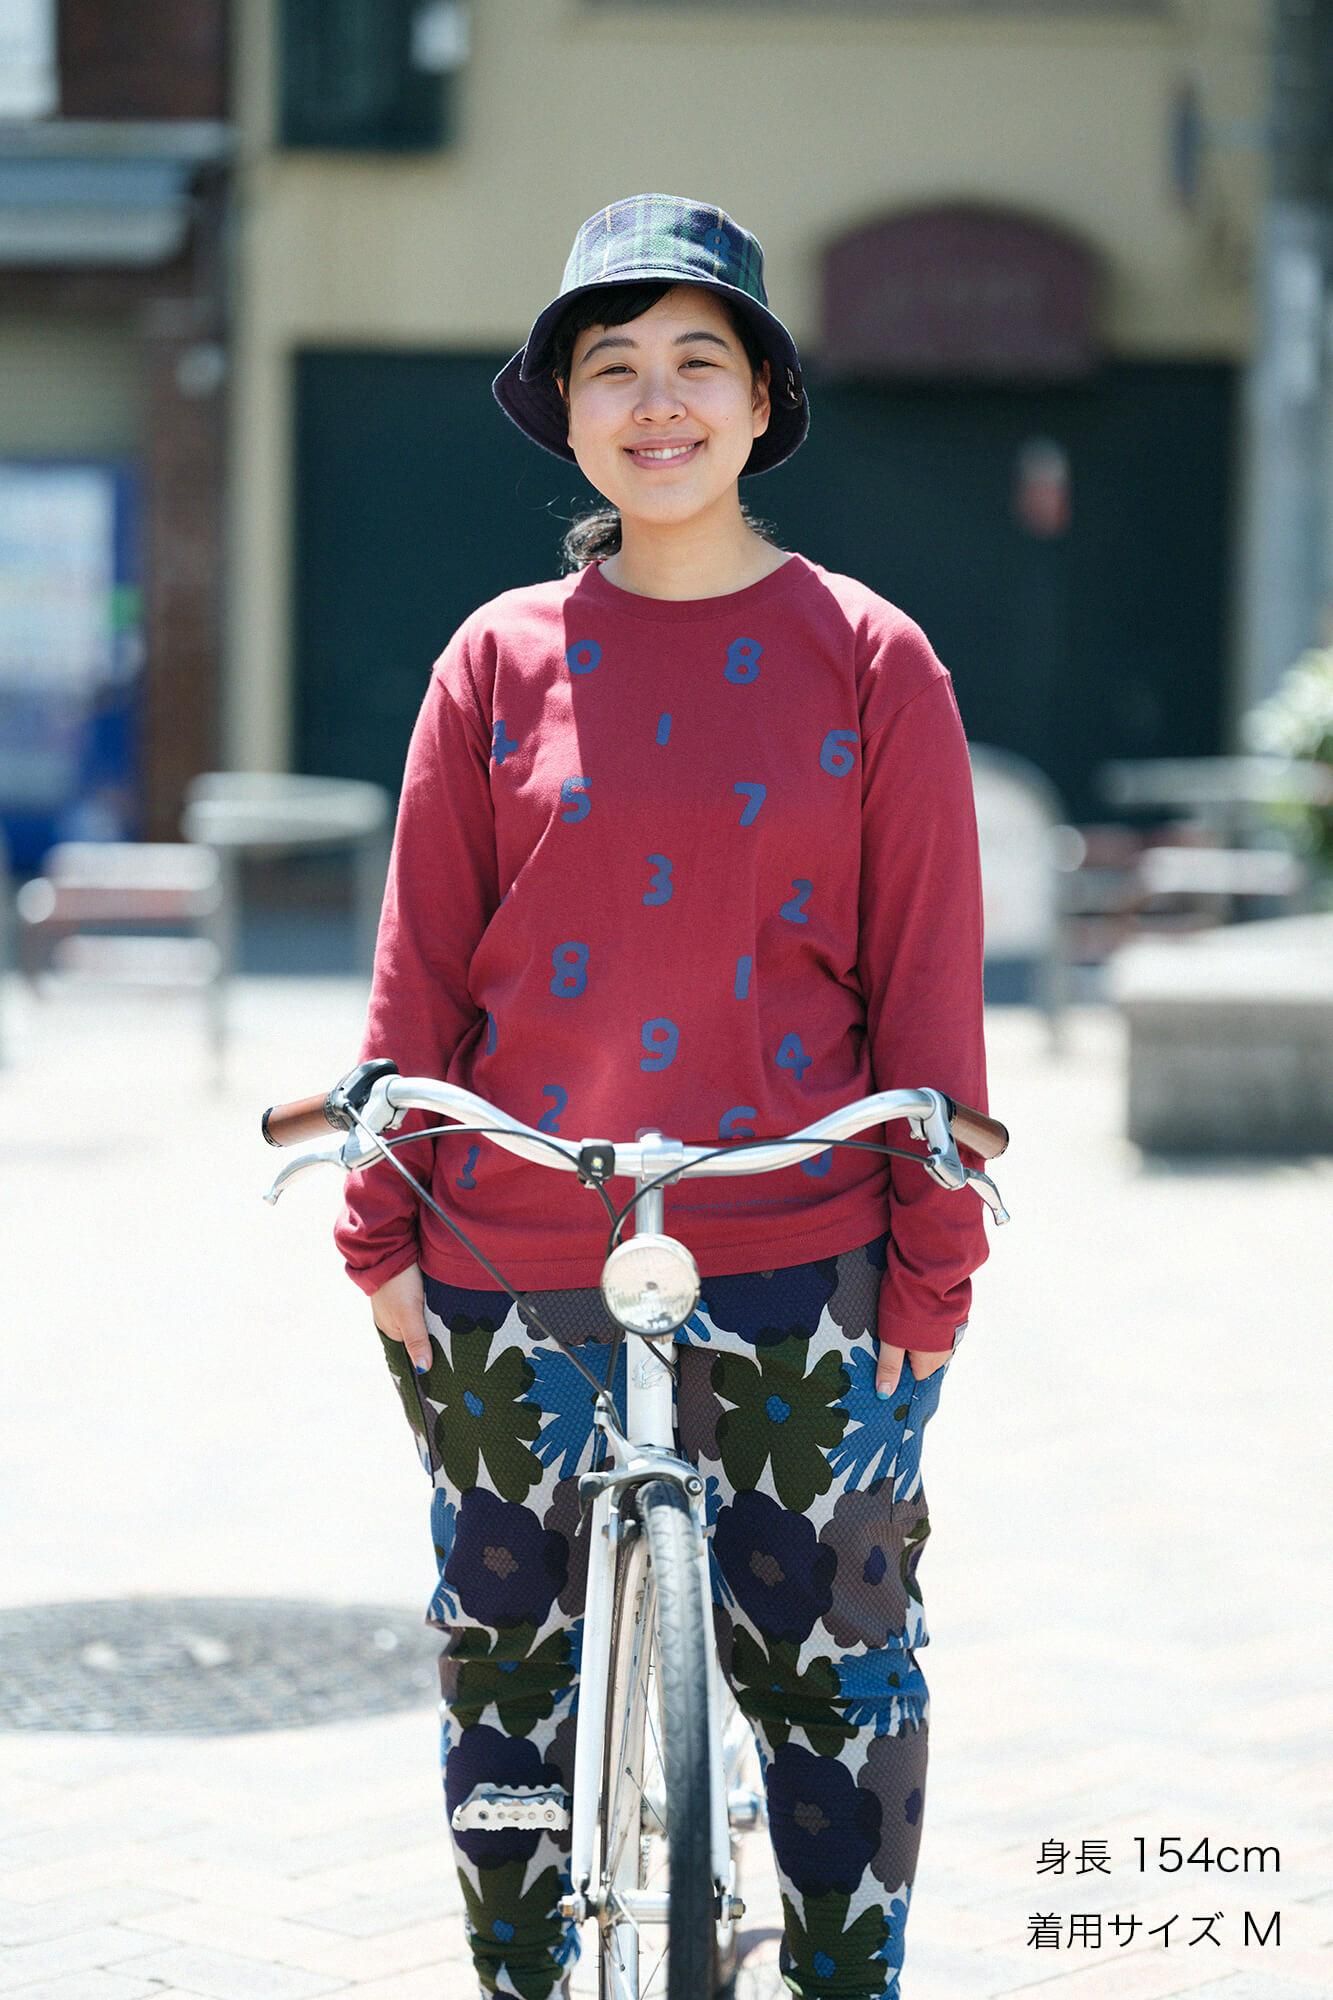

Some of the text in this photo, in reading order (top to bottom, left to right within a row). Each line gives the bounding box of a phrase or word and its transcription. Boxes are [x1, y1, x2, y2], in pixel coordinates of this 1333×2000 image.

[723, 637, 764, 685] 8
[655, 712, 673, 747] 1
[819, 729, 858, 779] 6
[560, 776, 593, 824] 5
[733, 781, 767, 828] 7
[643, 853, 674, 906] 3
[779, 878, 814, 925] 2
[550, 941, 591, 999] 8
[733, 955, 753, 1000] 1
[640, 1017, 680, 1073] 9
[775, 1032, 813, 1082] 4
[537, 1084, 568, 1133] 2
